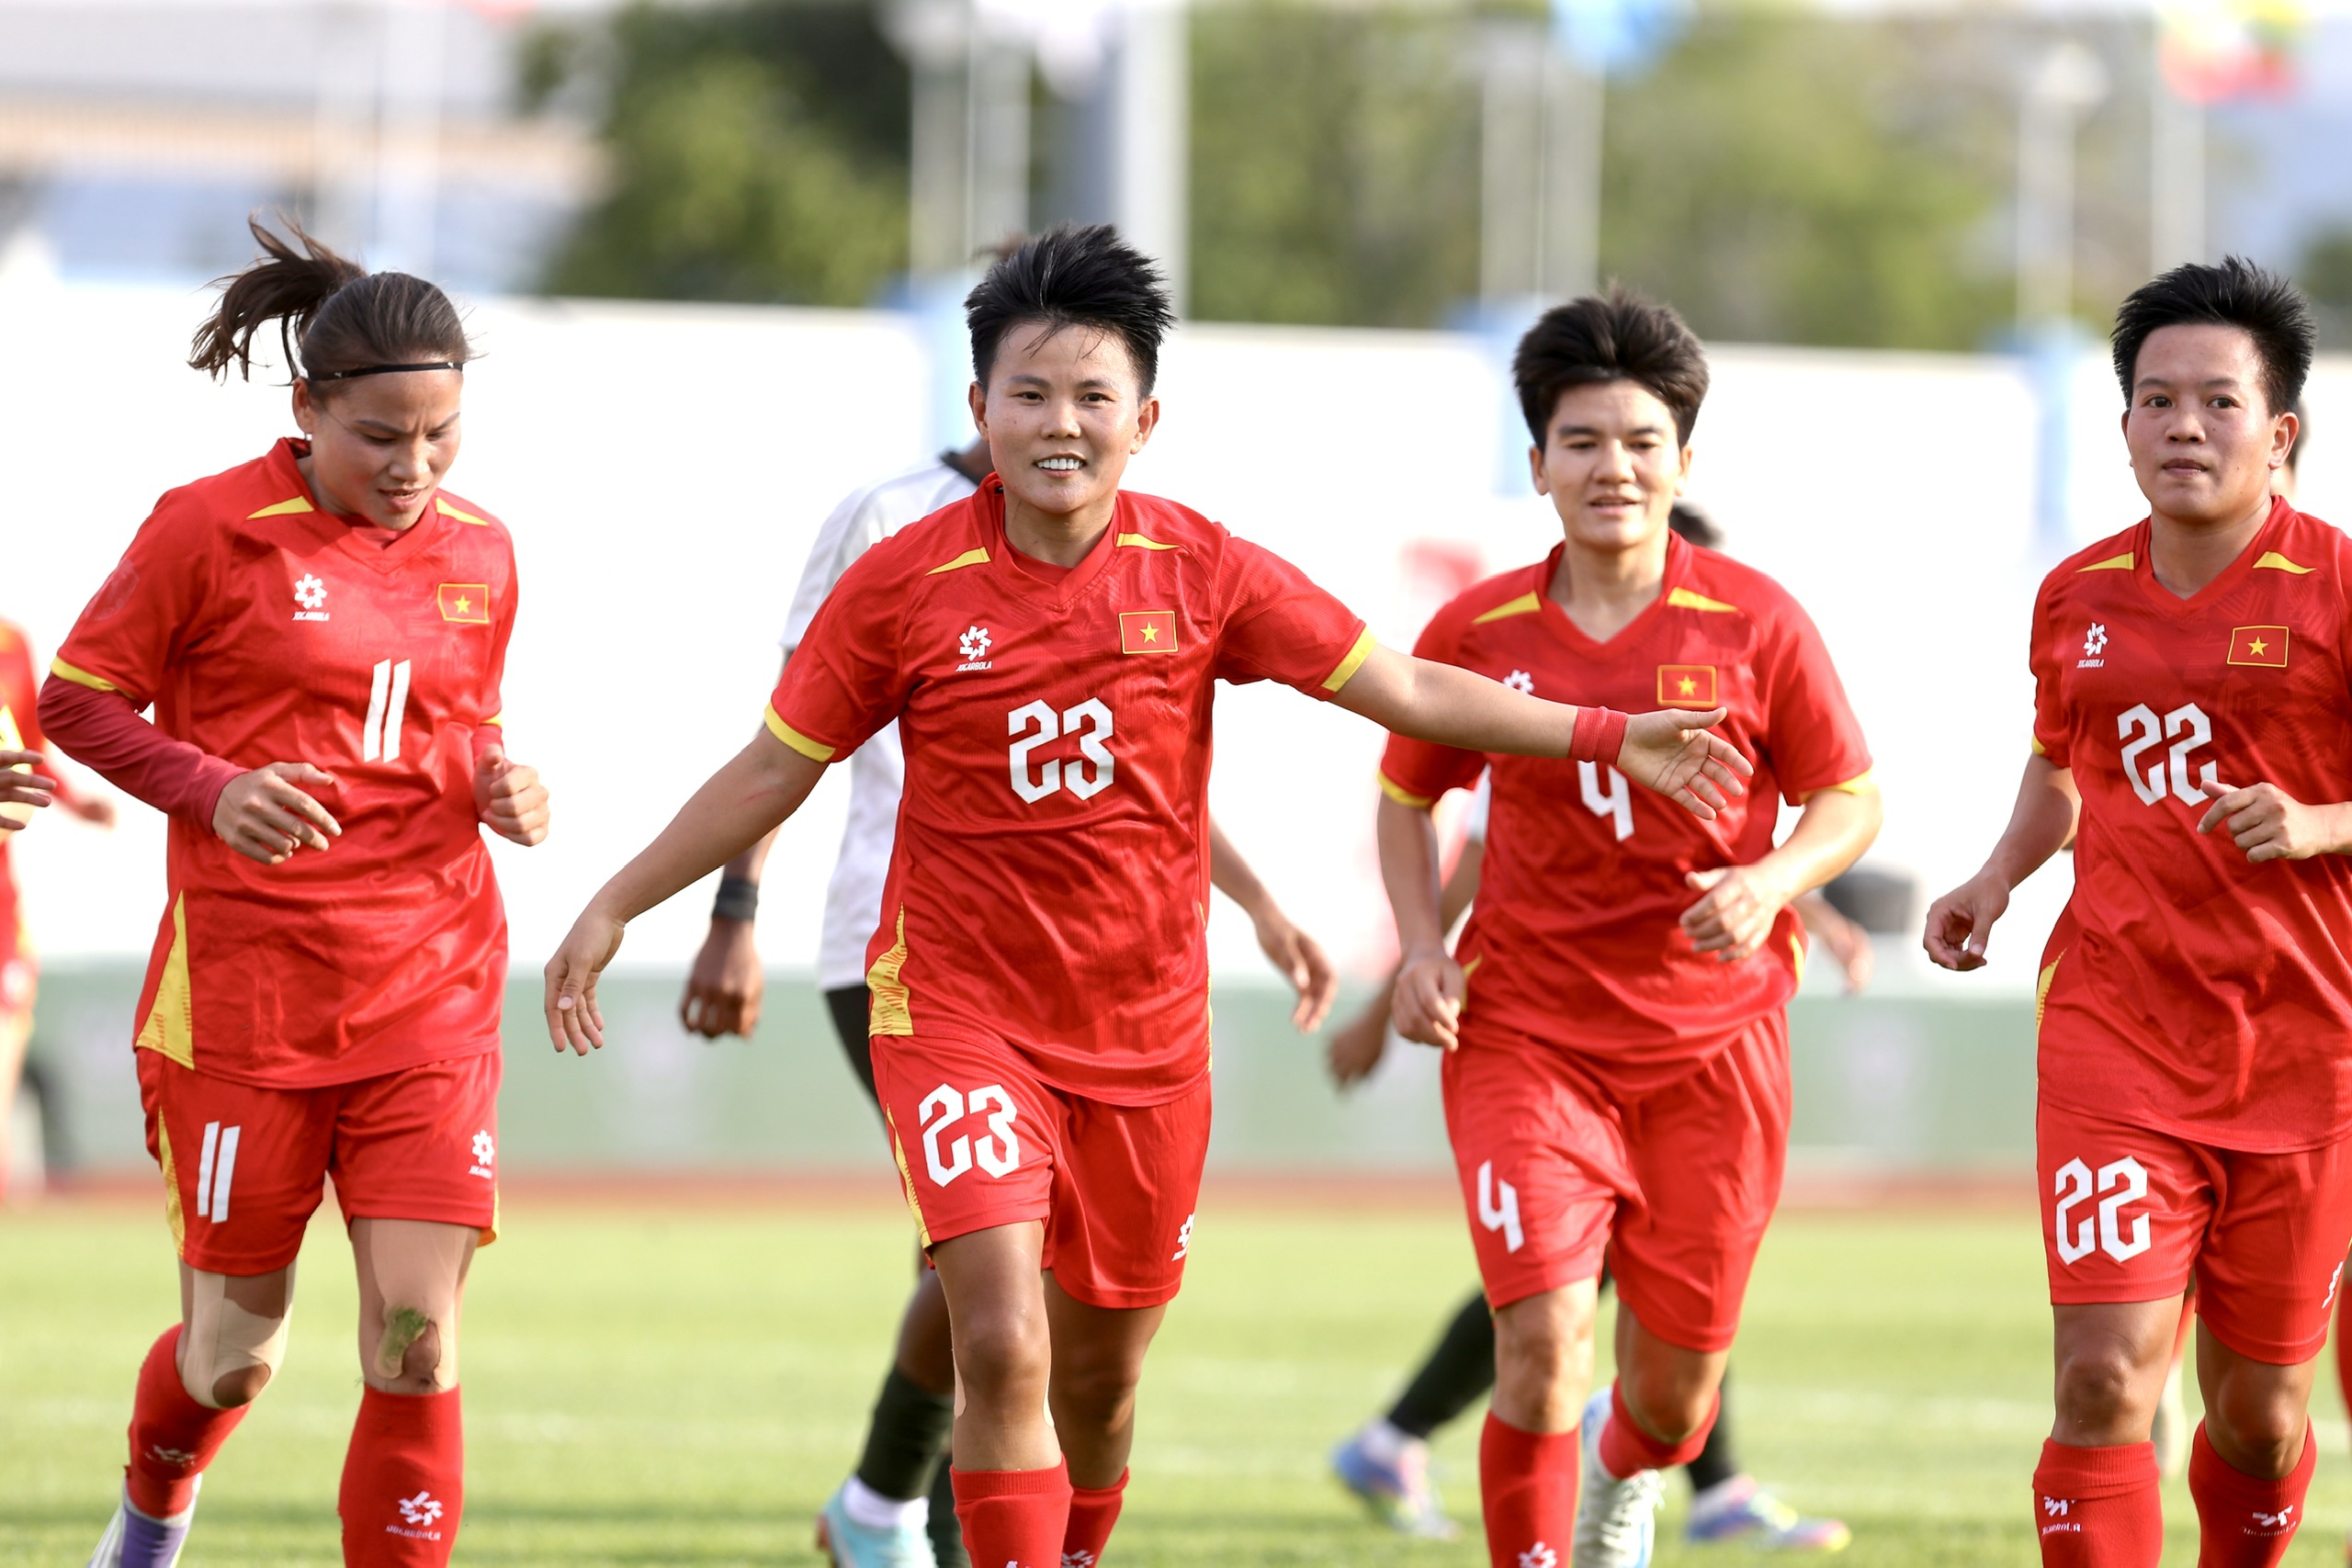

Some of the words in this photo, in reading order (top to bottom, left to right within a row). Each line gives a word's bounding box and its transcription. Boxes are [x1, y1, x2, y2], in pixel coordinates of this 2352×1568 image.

[362, 659, 412, 764] 11
[1008, 697, 1114, 805] 23
[2117, 702, 2218, 807] 22
[1578, 761, 1634, 841] 4
[197, 1121, 241, 1224] 11
[918, 1082, 1021, 1189] 23
[1476, 1160, 1525, 1253] 4
[2054, 1156, 2152, 1266] 22
